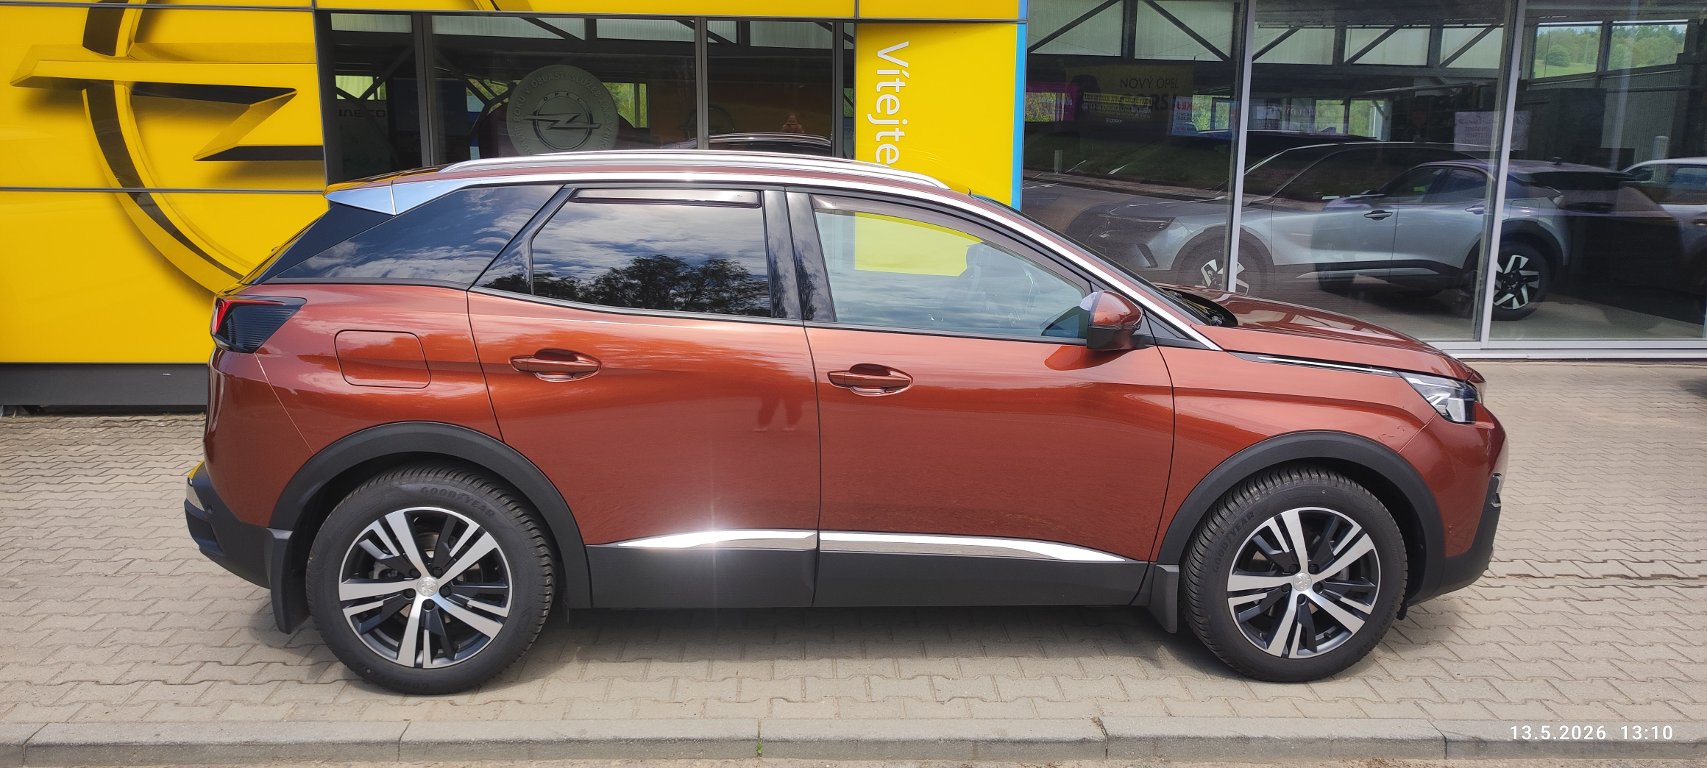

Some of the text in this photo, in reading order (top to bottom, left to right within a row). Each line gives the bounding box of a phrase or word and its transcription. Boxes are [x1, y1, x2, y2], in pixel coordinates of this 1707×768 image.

[867, 41, 910, 165] Vítejte
[1119, 76, 1179, 89] NOVÝ OPEL
[420, 486, 496, 518] GOODYEAR
[1212, 511, 1255, 574] GOODYEAR
